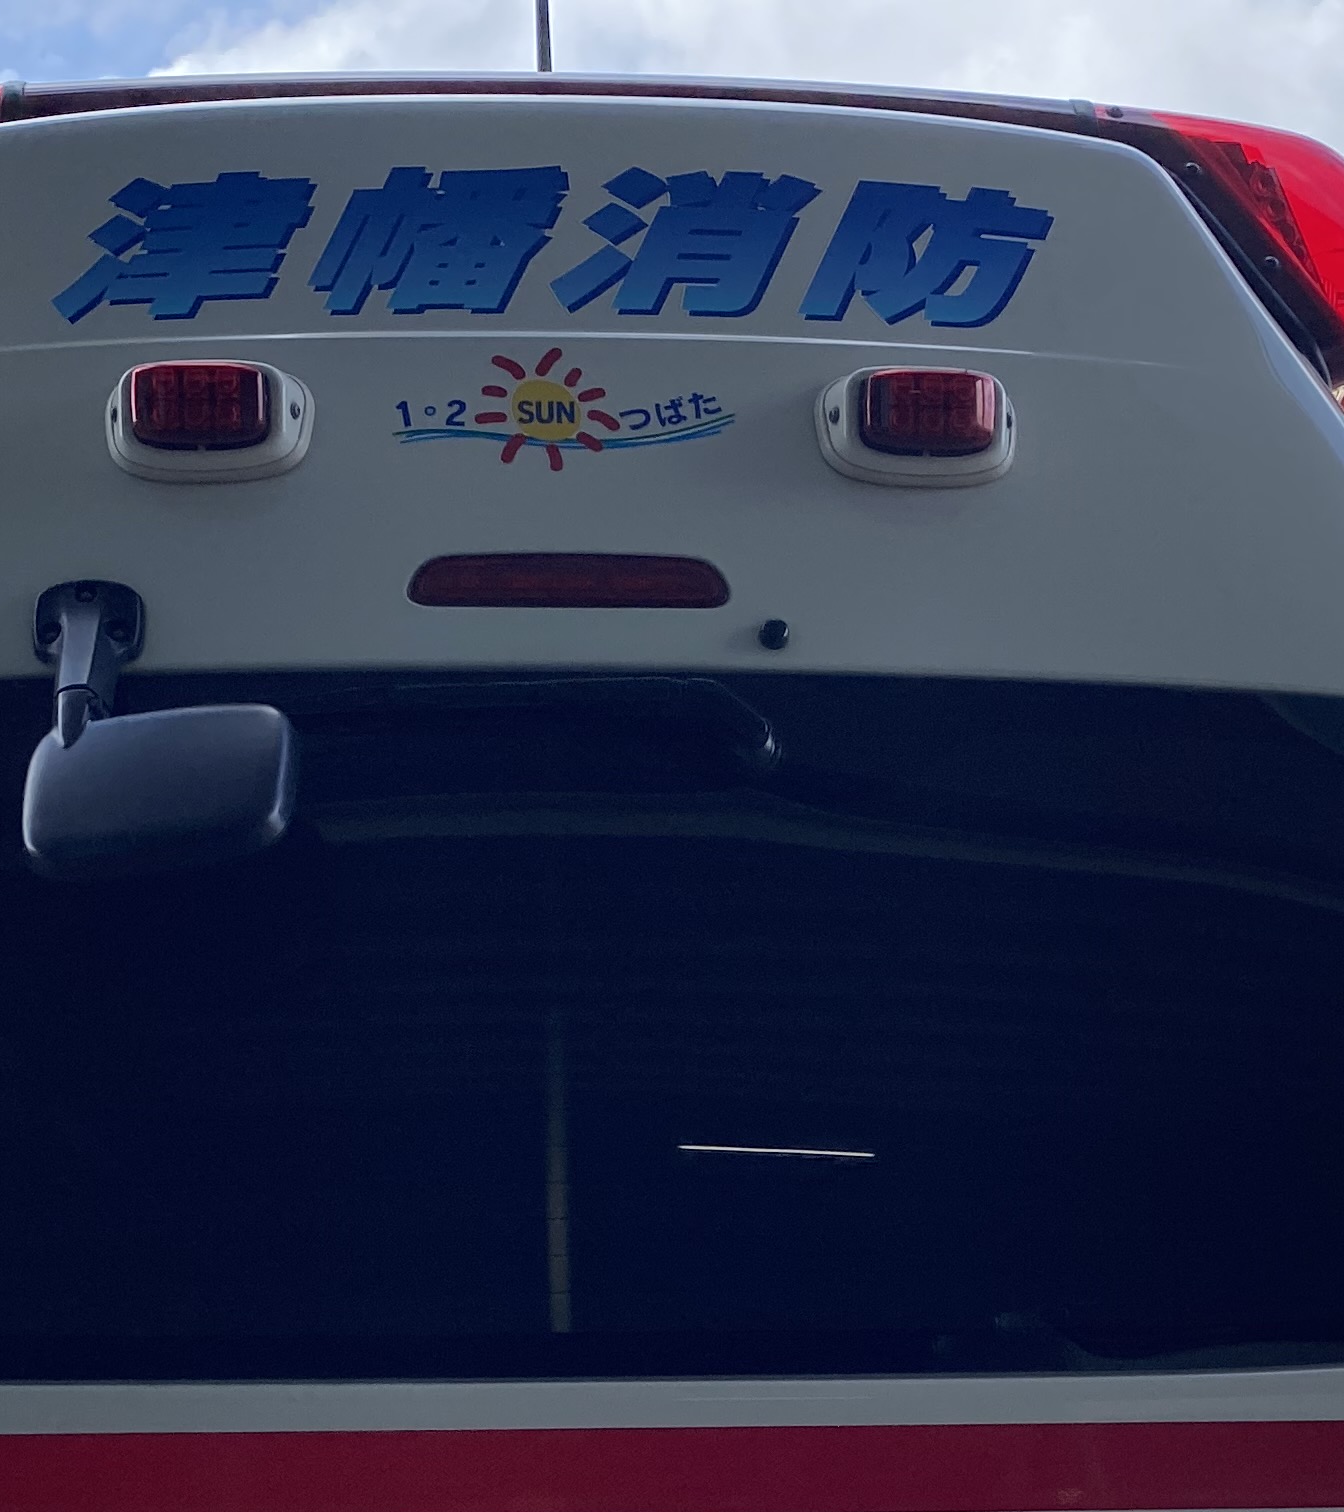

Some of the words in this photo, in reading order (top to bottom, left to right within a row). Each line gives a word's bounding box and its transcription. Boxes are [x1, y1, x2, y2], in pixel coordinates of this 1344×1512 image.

[52, 166, 1054, 328] 津幡消防
[517, 400, 576, 425] SUN
[618, 391, 723, 431] つばた
